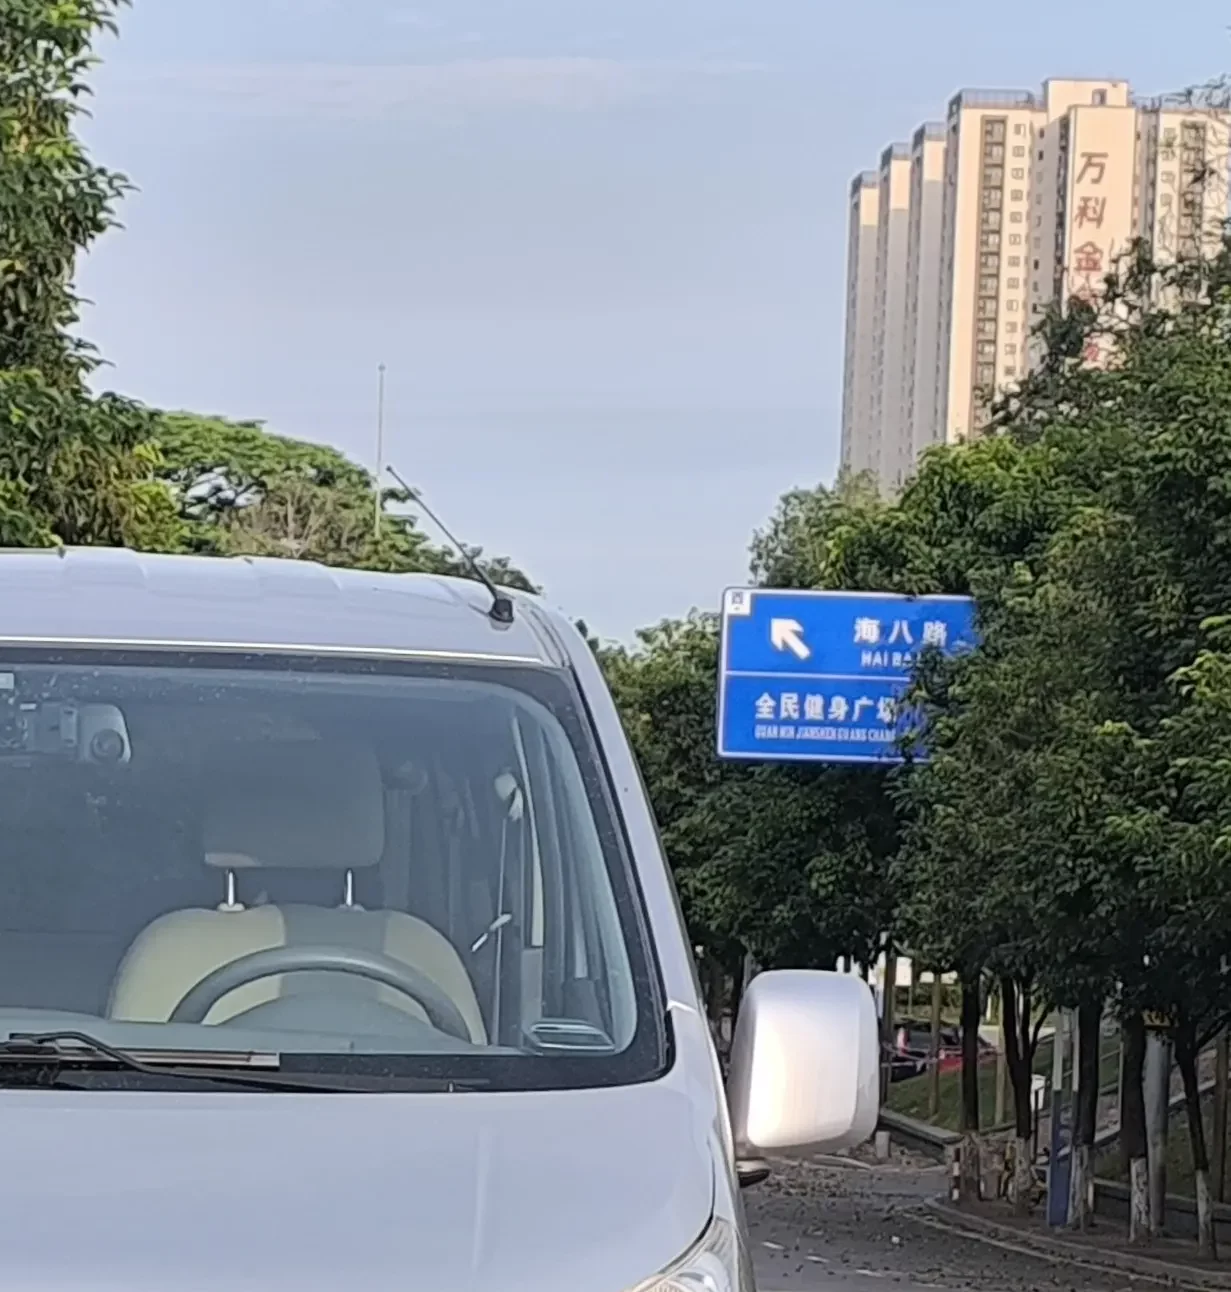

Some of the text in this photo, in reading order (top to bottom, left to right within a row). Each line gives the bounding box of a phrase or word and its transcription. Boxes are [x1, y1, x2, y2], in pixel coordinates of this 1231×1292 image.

[1074, 151, 1109, 361] 万科金
[853, 617, 948, 648] 海八路
[860, 650, 889, 668] HAI
